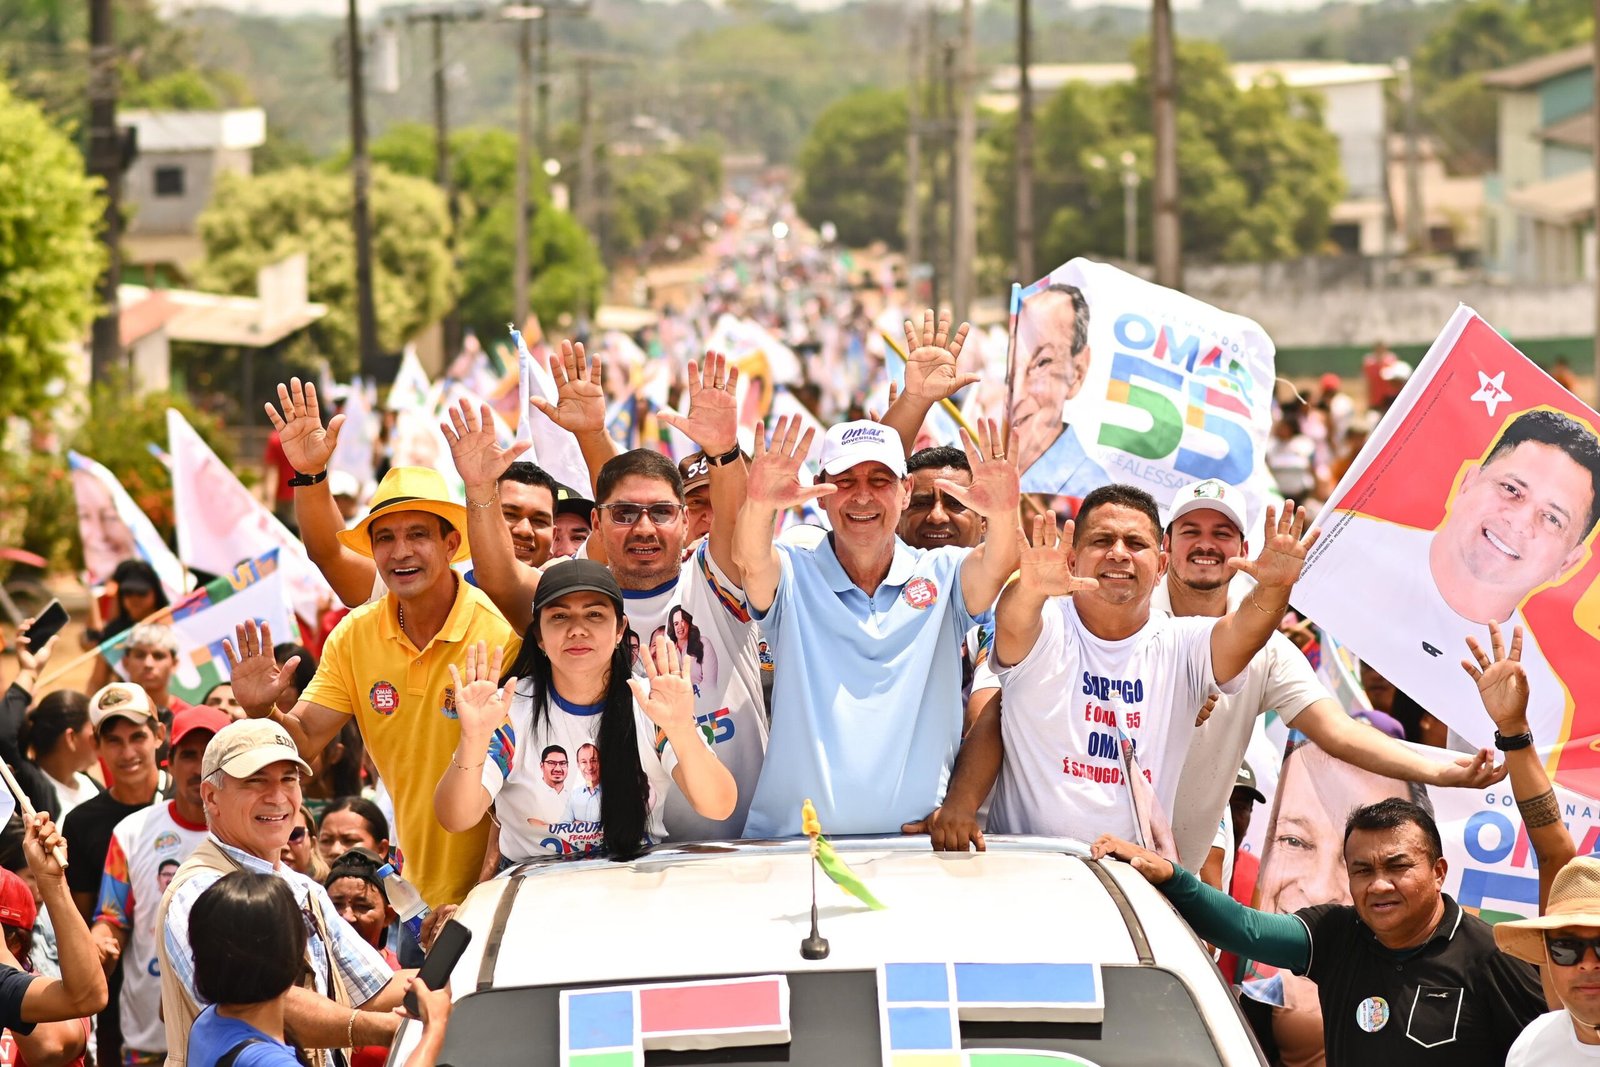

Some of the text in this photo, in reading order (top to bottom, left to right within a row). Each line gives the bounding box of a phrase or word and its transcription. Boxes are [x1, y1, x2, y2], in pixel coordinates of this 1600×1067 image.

[1483, 382, 1502, 399] PT
[1097, 352, 1254, 486] 55
[911, 589, 932, 604] 55
[1082, 671, 1144, 704] SABUGO
[376, 695, 394, 707] 55
[1085, 702, 1141, 729] É OMA 55
[1088, 731, 1136, 760] OM
[1071, 760, 1120, 785] SABUGO
